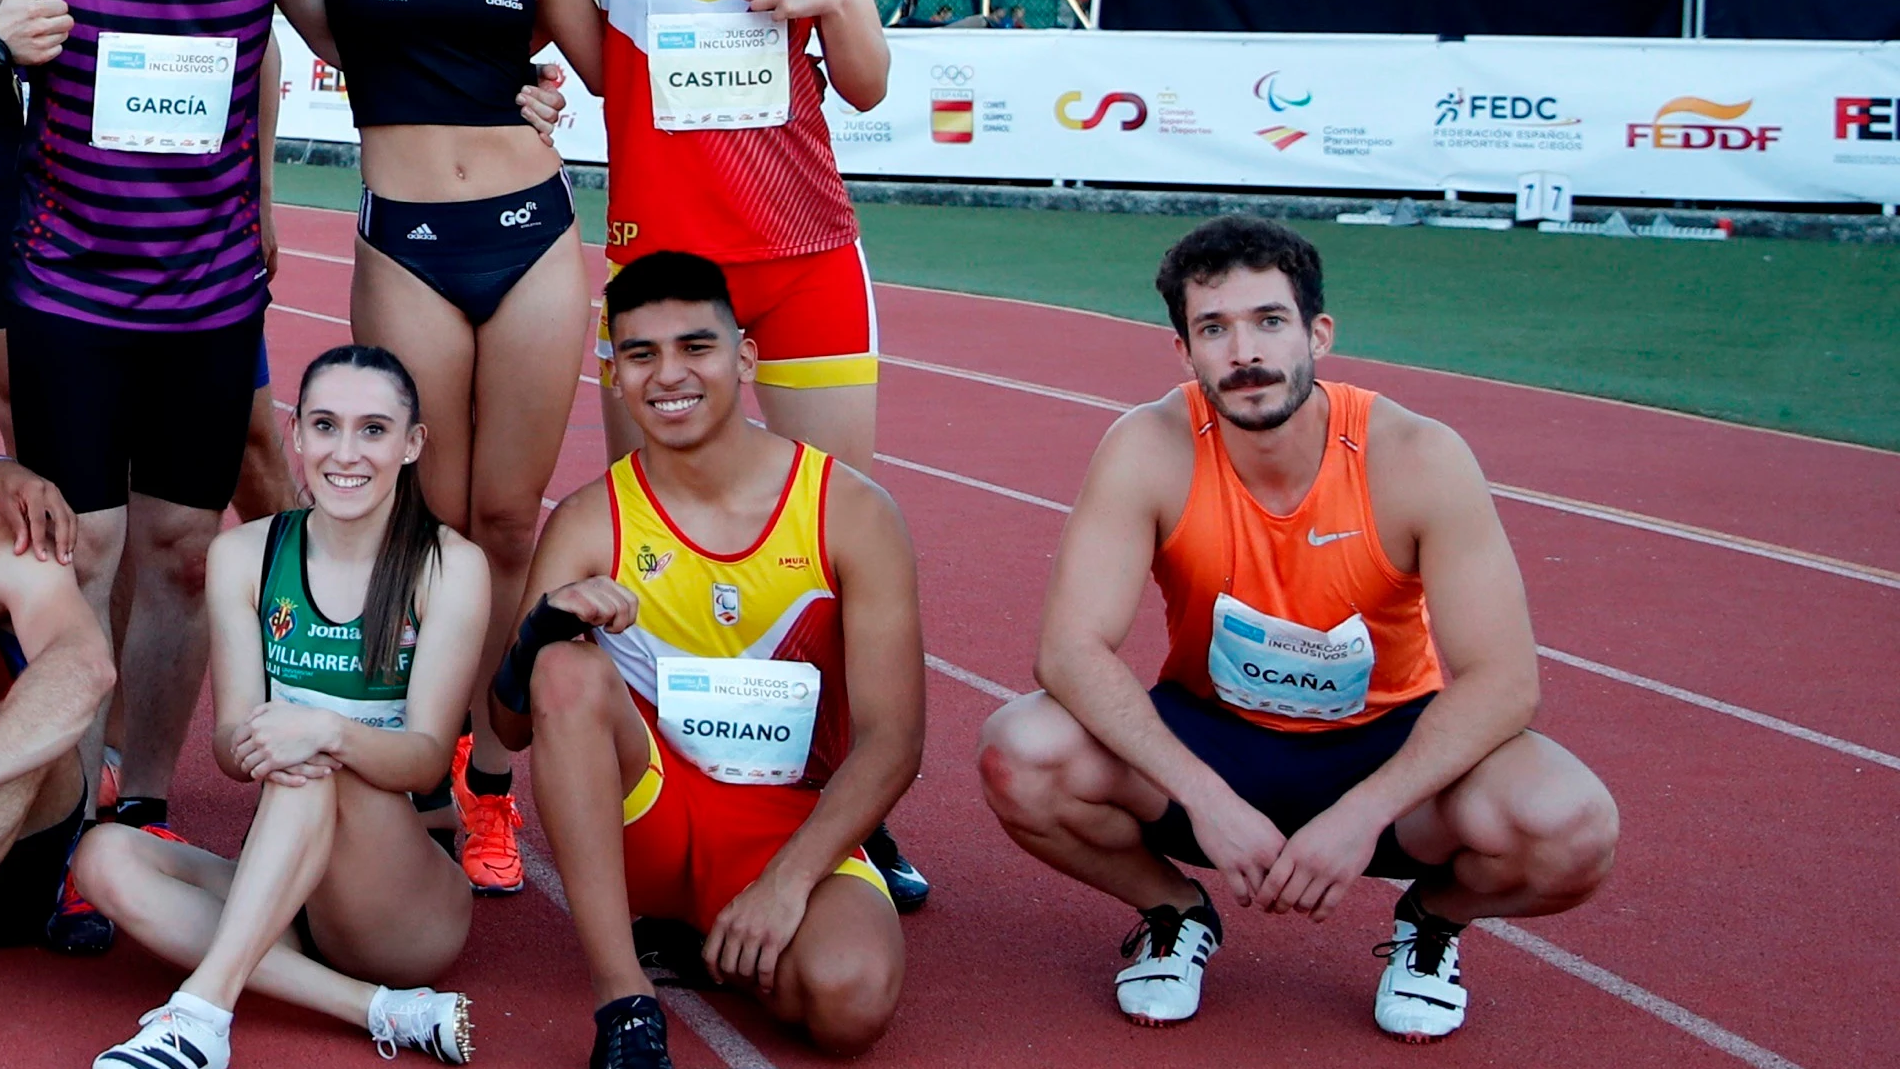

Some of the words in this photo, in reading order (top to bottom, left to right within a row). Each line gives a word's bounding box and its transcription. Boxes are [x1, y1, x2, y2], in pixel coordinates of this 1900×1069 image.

[725, 28, 765, 39] JUEGOS
[699, 38, 765, 50] INCLUSIVOS
[176, 54, 215, 64] JUEGOS
[148, 62, 214, 74] INCLUSIVOS
[669, 69, 773, 87] CASTILLO
[126, 95, 207, 116] GARCÍA
[1470, 95, 1557, 120] FEDC
[1158, 107, 1194, 117] Consejo
[843, 120, 891, 131] JUEGOS
[1158, 116, 1196, 126] Superior
[1171, 126, 1212, 135] Deportes
[1432, 128, 1513, 139] FEDERACIÓN
[1516, 129, 1582, 140] ESPAÑOLA
[830, 132, 892, 142] CLUSIVOS
[1625, 123, 1782, 151] FEDDF
[1448, 139, 1510, 149] DEPORTES
[1537, 141, 1583, 150] CIEGOS
[525, 201, 538, 211] fit
[406, 233, 438, 241] adidas
[778, 557, 810, 566] AMURA
[1268, 639, 1348, 660] INCLUSIVOS
[1300, 640, 1348, 652] JUEGOS
[268, 641, 363, 672] VILLARREA
[1243, 662, 1337, 691] OCAÑA
[743, 677, 789, 689] JUEGOS
[714, 685, 789, 699] INCLUSIVOS
[682, 718, 791, 742] SORIANO
